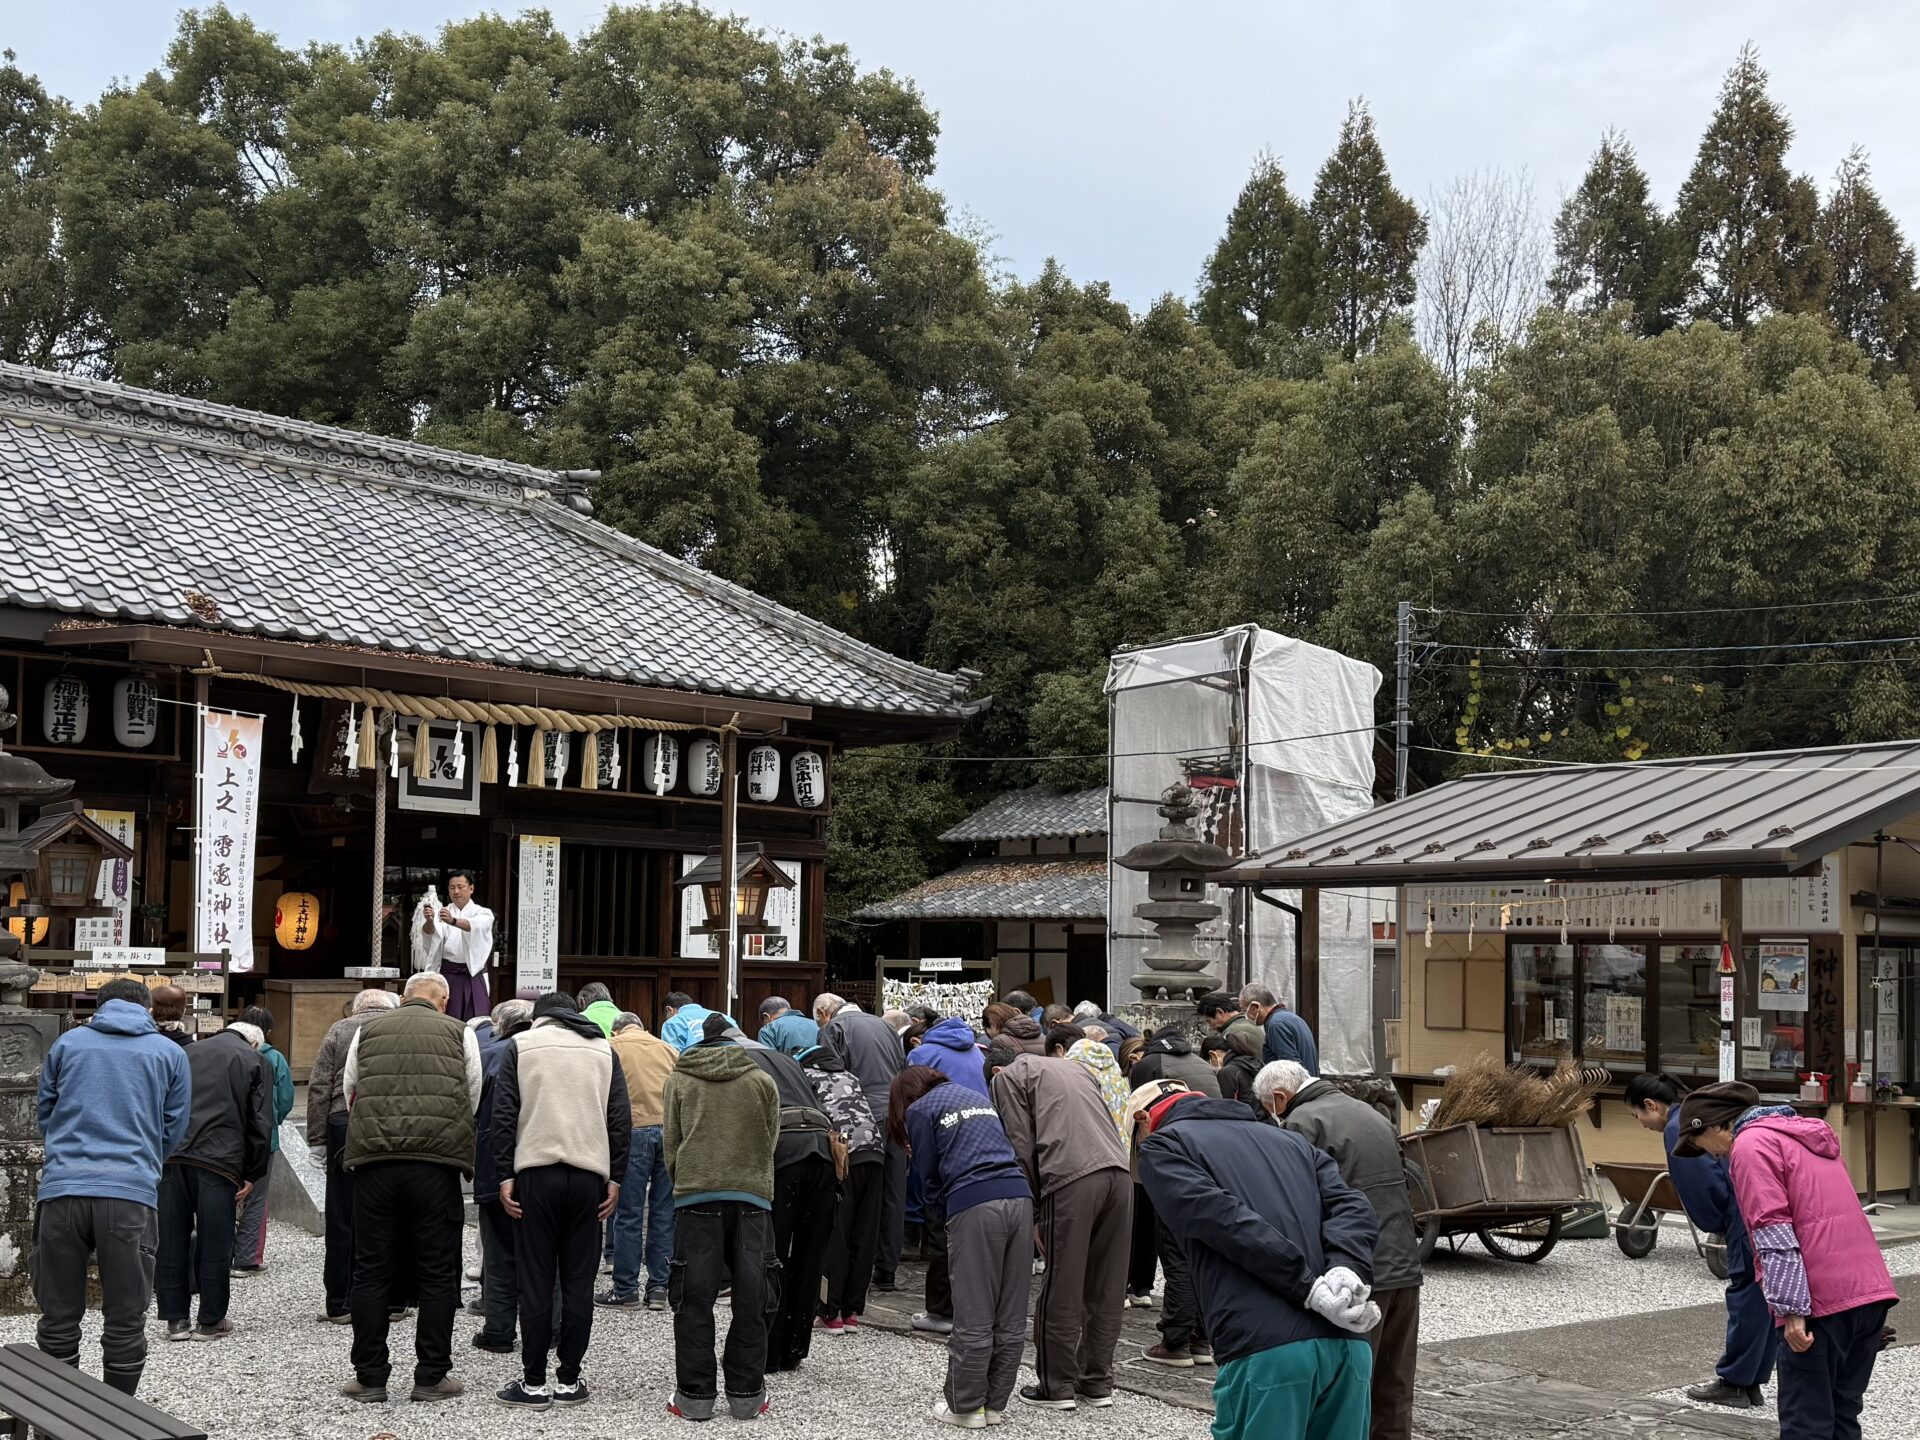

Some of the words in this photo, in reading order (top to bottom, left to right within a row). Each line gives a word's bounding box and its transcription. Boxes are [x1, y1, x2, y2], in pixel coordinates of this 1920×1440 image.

[764, 750, 776, 772] 総代
[795, 757, 816, 808] 宮本和彦
[294, 898, 309, 944] 上之村神社
[101, 951, 152, 961] 絵馬掛け
[1722, 980, 1733, 1002] 呼鈴
[1883, 960, 1896, 1009] 受付
